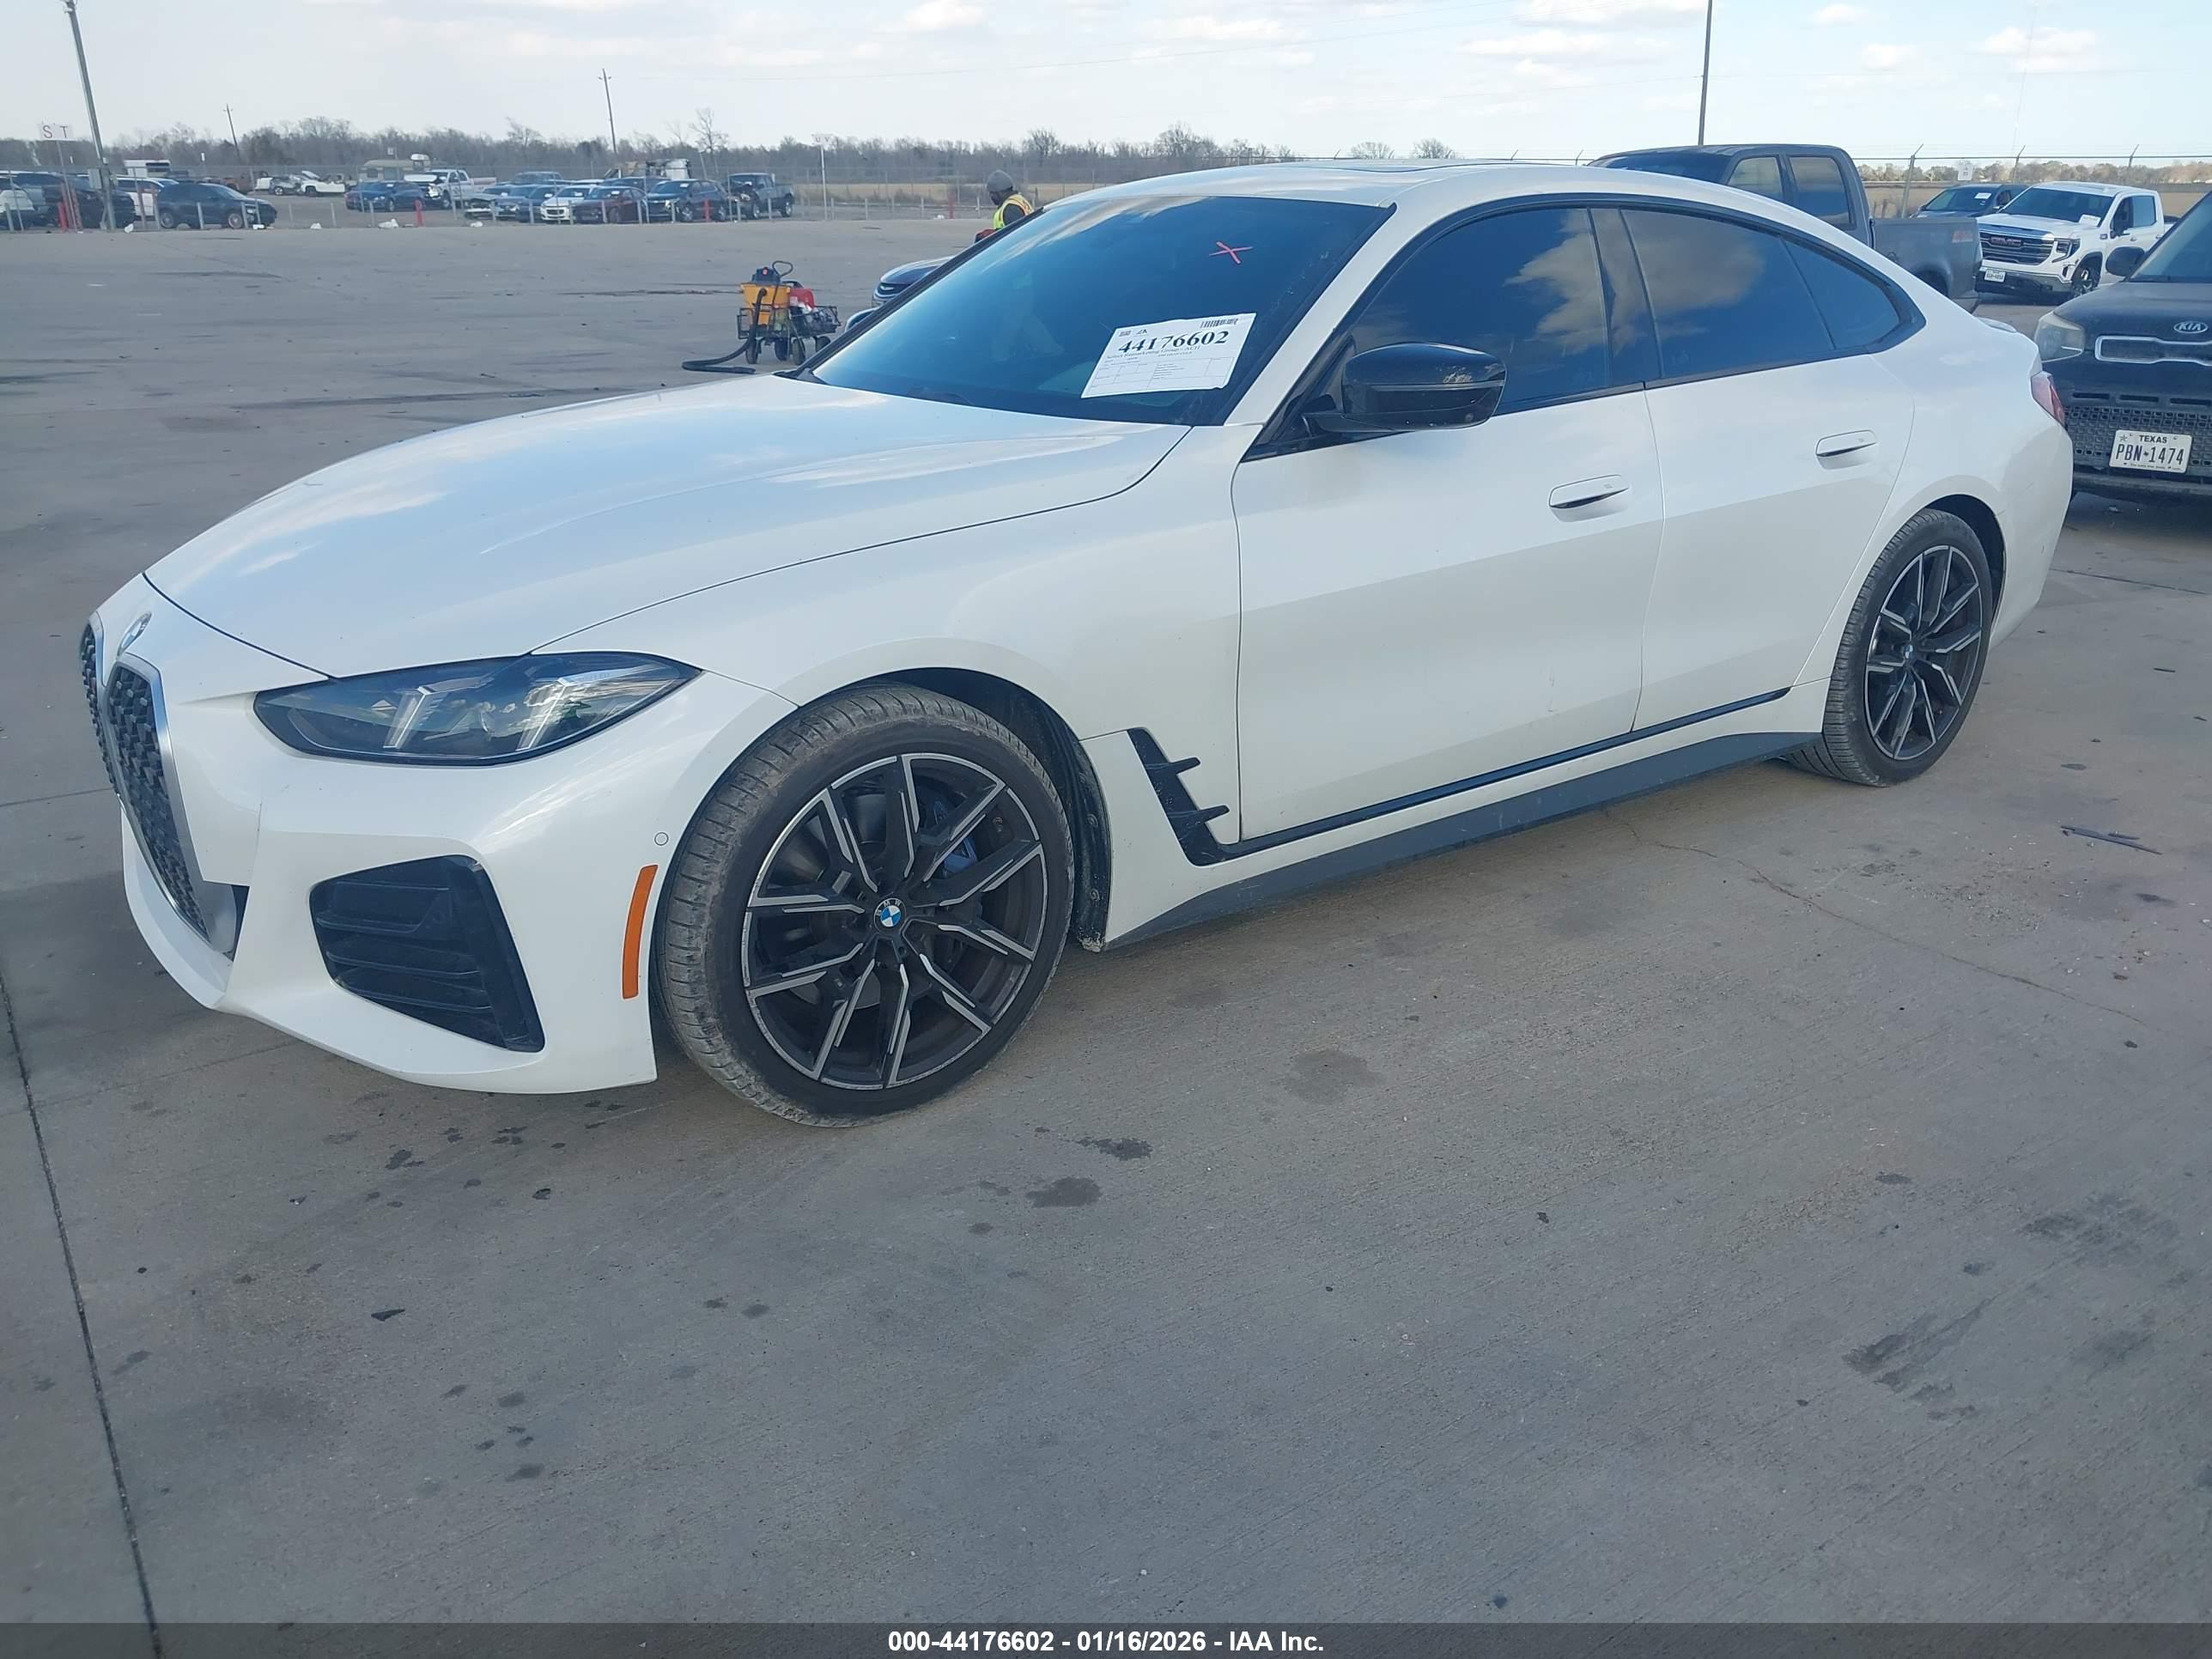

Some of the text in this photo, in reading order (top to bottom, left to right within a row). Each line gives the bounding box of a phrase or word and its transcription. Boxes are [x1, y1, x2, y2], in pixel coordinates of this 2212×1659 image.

[2179, 322, 2202, 331] KIA
[1118, 330, 1230, 354] 44176602
[2139, 434, 2167, 444] TEXAS
